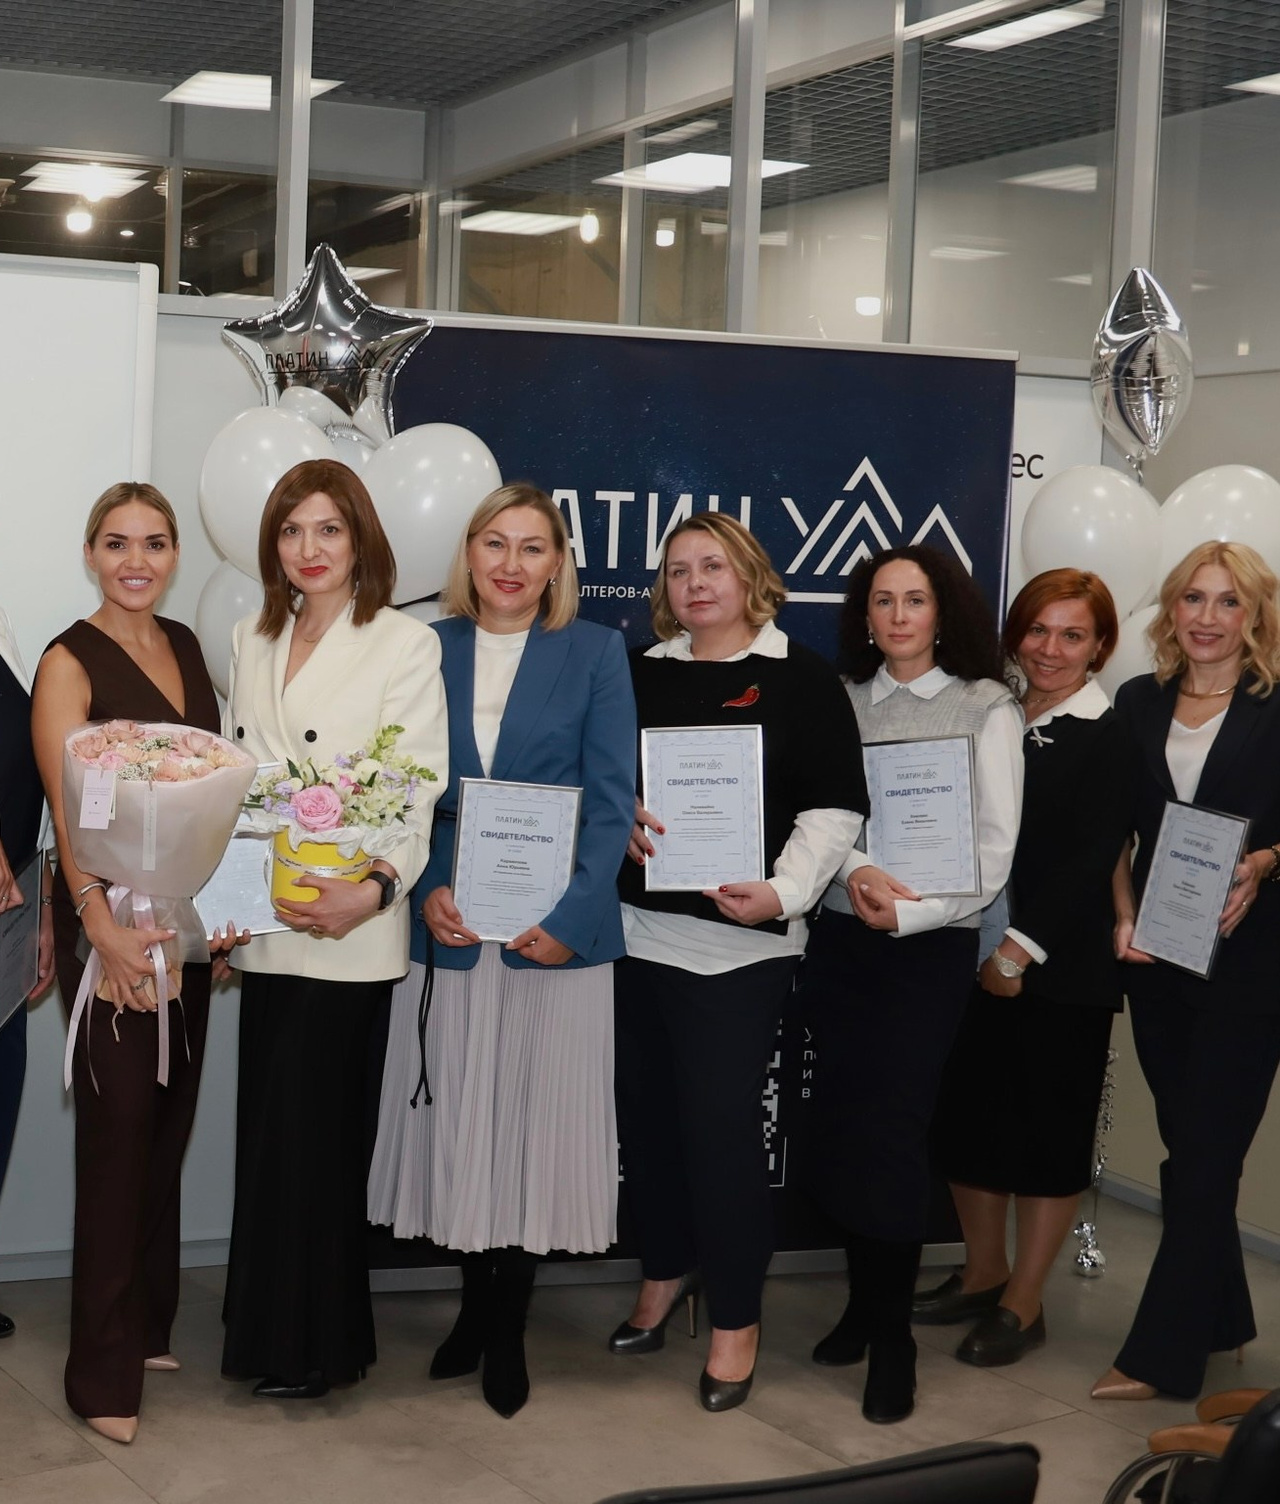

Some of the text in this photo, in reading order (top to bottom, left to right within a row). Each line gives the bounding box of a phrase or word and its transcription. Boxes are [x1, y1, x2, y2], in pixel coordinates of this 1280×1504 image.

[666, 777, 738, 786] СВИДЕТЕЛЬСТВО
[885, 785, 953, 798] СВИДЕТЕЛЬСТВО
[480, 830, 554, 843] СВИДЕТЕЛЬСТВО
